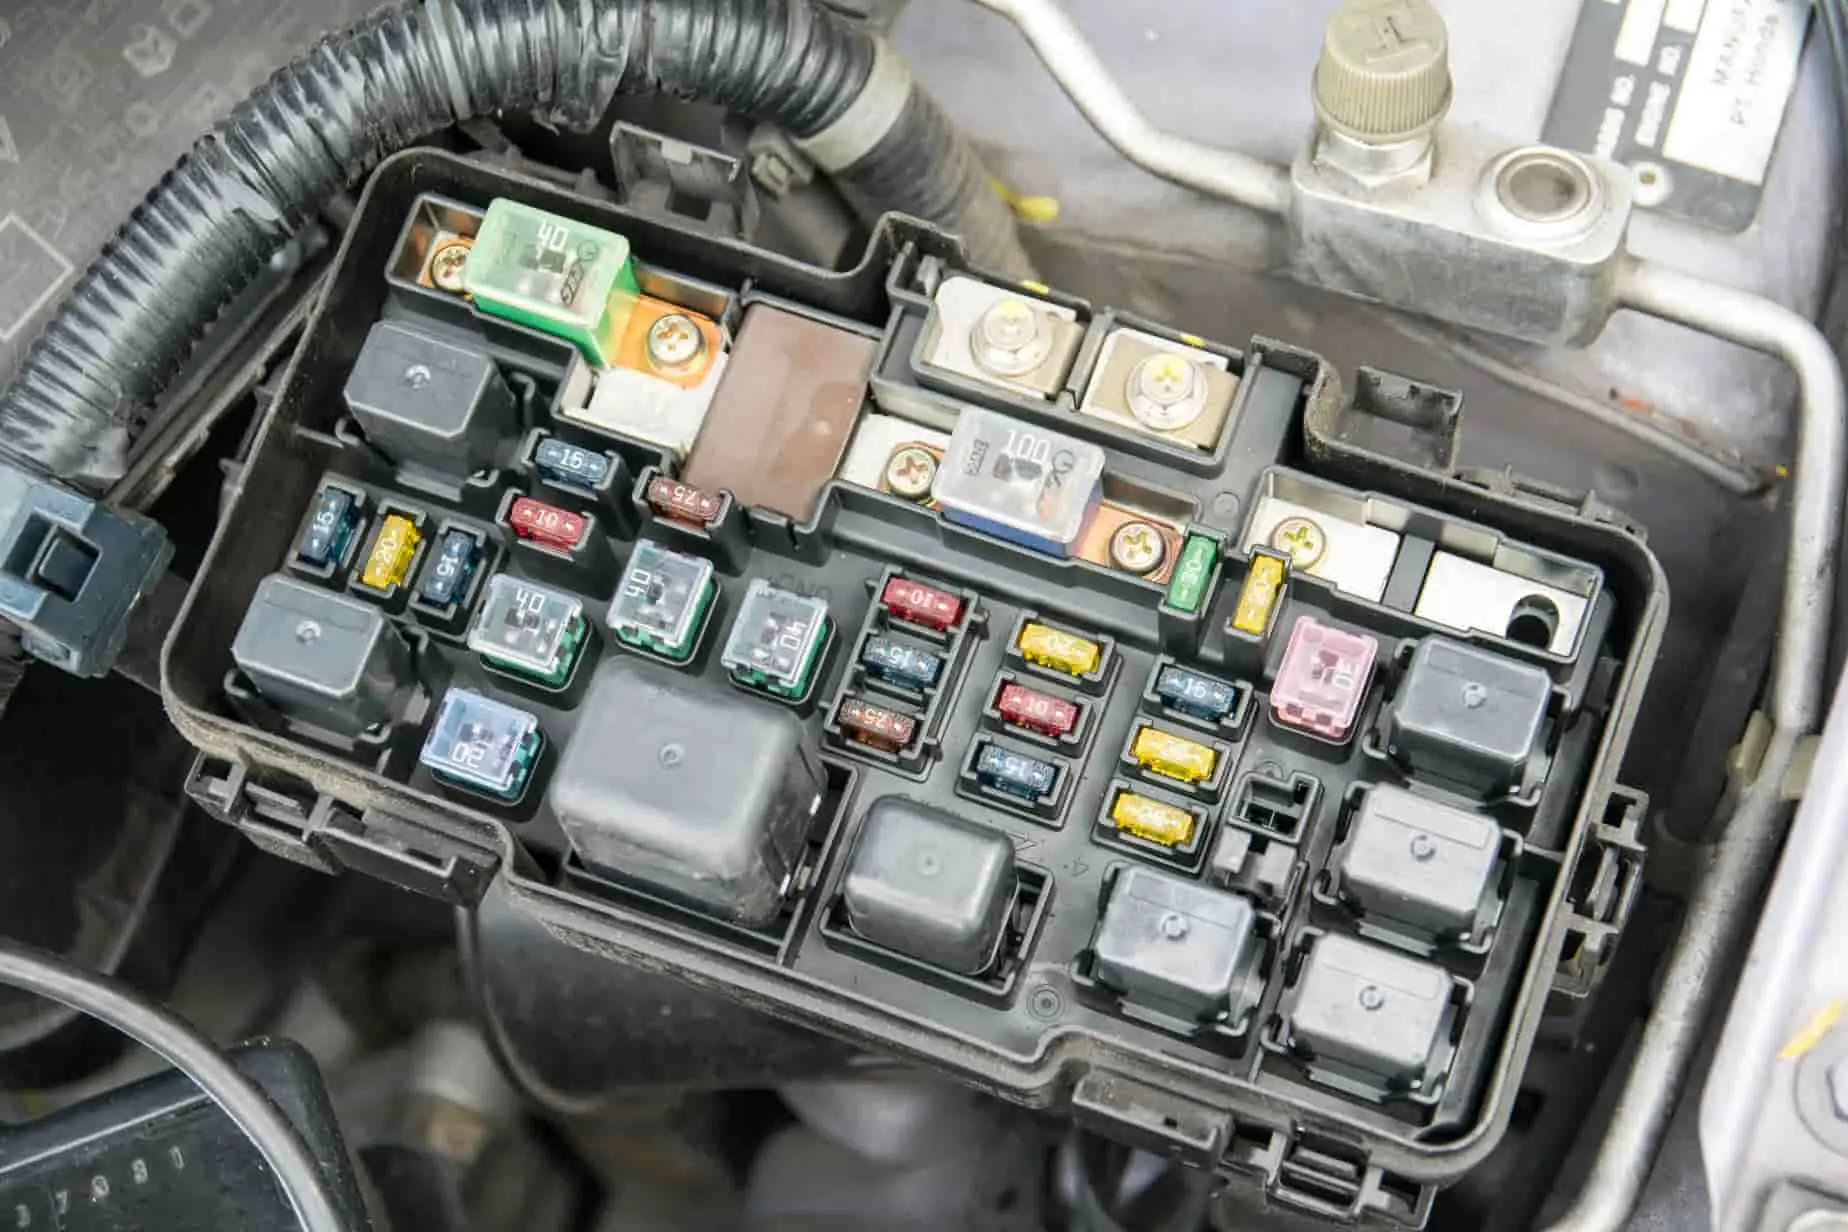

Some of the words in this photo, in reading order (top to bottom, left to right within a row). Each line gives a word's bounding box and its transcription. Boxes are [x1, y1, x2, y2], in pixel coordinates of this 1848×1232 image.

[537, 220, 568, 250] 40
[559, 448, 584, 468] 15
[1000, 429, 1050, 464] 100
[313, 510, 334, 533] 15
[536, 509, 560, 529] 10
[374, 537, 398, 565] 20
[437, 553, 460, 576] 15
[625, 568, 651, 597] 40
[516, 588, 545, 612] 40
[911, 589, 932, 609] 10
[779, 621, 807, 650] 40
[889, 647, 908, 667] 15
[452, 740, 487, 768] 20
